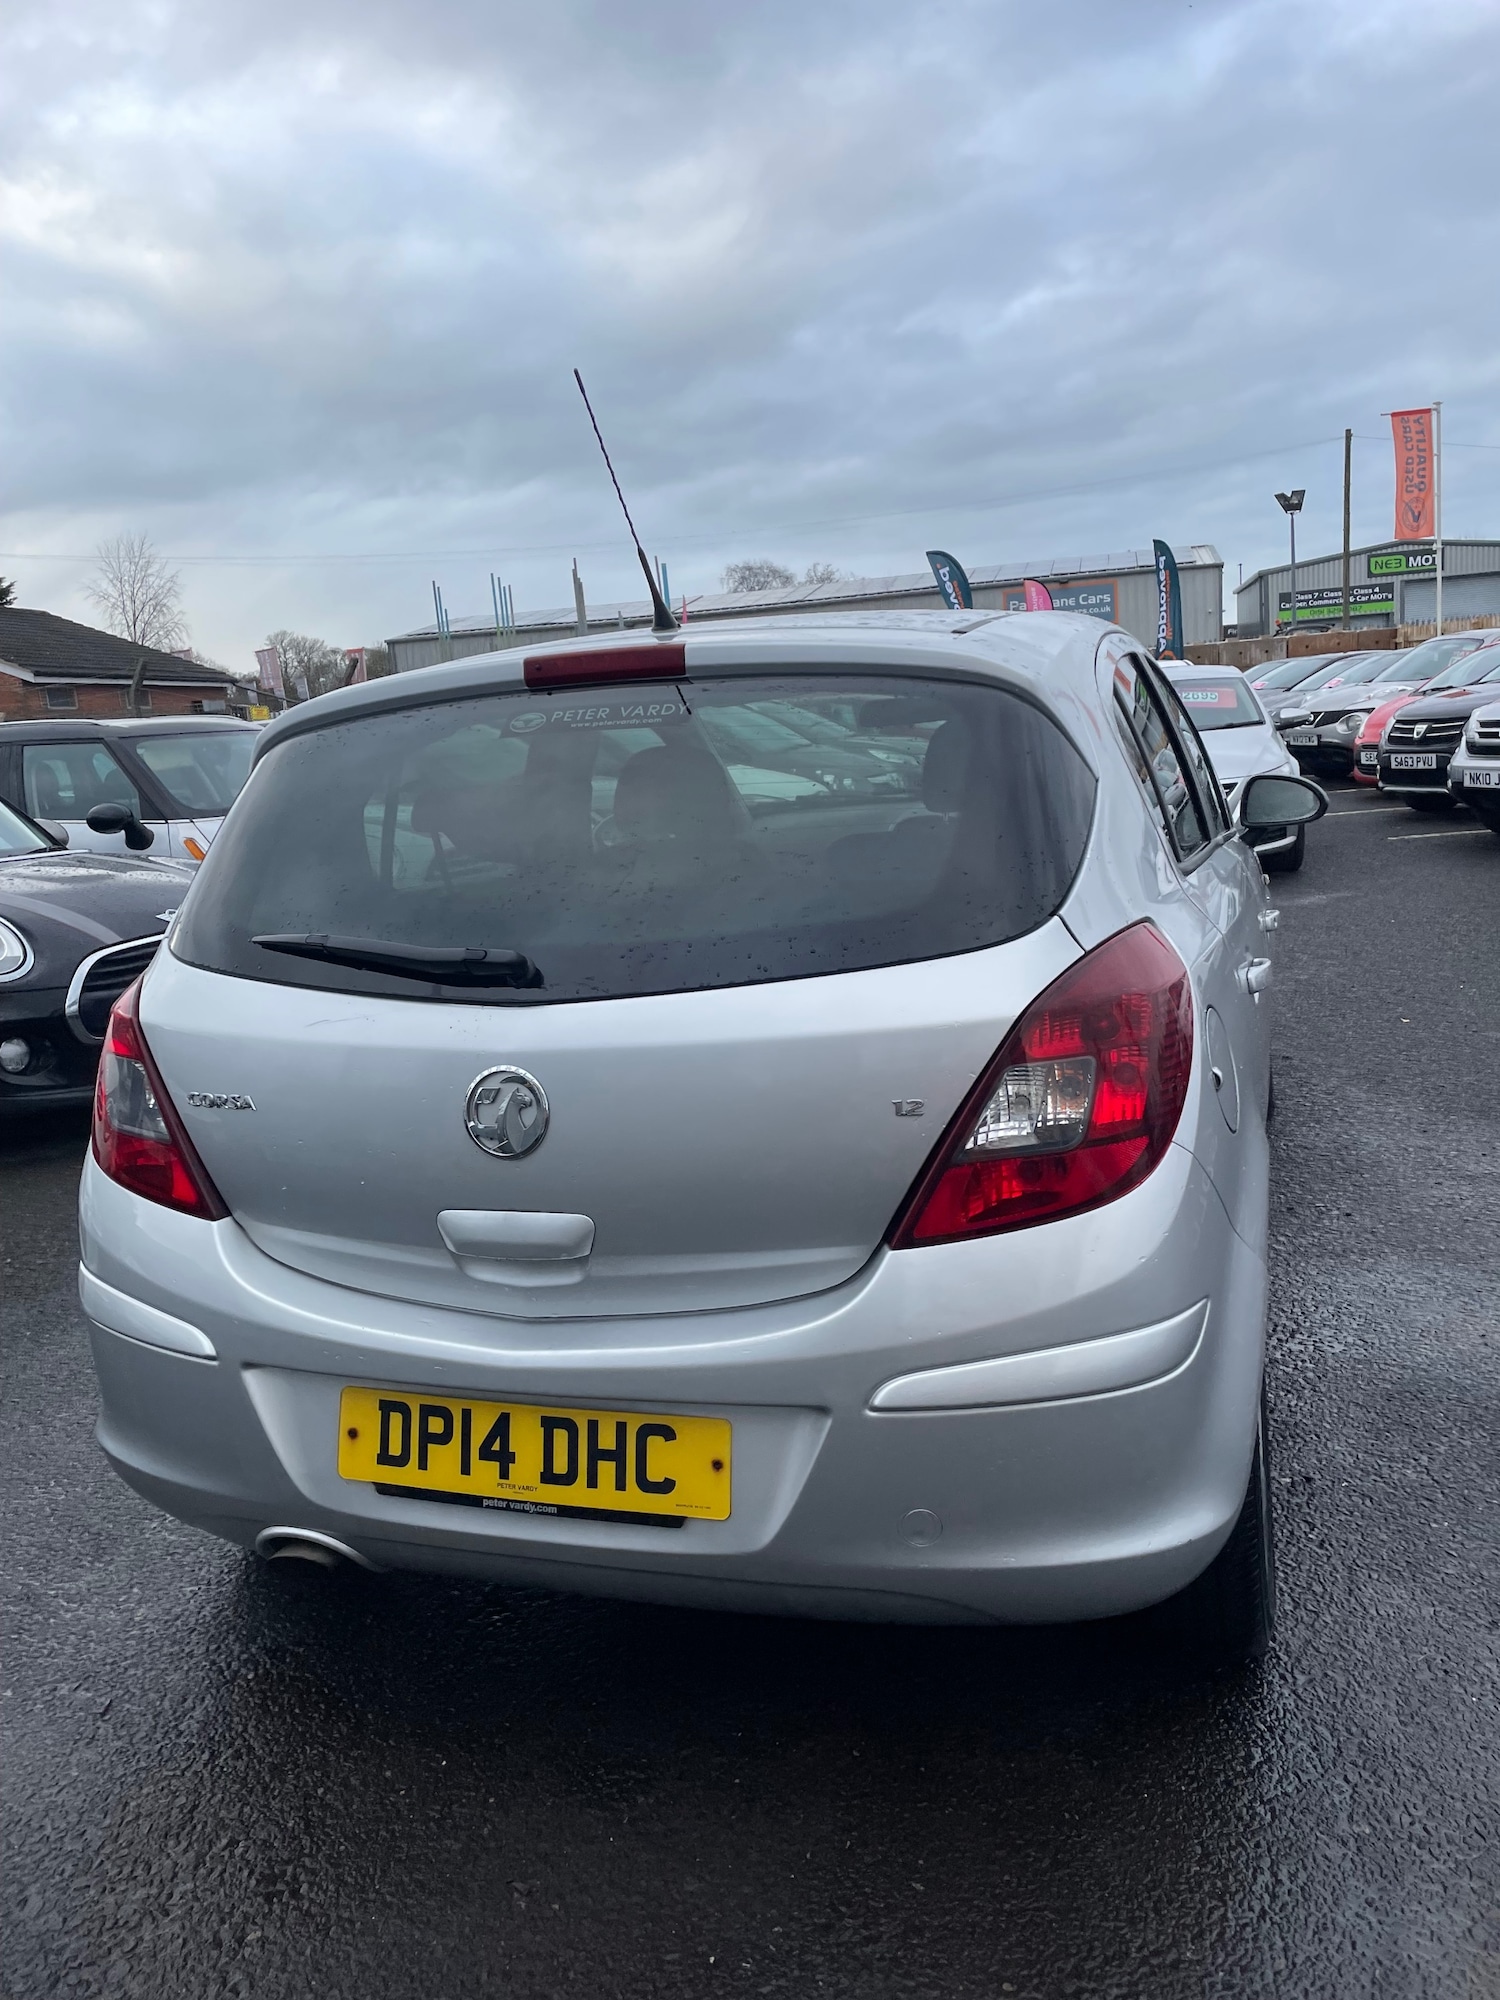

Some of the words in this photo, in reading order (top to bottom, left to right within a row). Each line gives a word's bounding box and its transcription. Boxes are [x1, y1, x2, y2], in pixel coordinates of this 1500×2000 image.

[1079, 594, 1111, 605] Cars
[1356, 594, 1370, 602] Car
[551, 707, 610, 723] PETER
[620, 703, 690, 718] VARDY
[570, 717, 663, 728] www.petervardy.com
[1394, 755, 1415, 768] SA63
[1416, 755, 1433, 768] PVU
[186, 1091, 257, 1112] CORSA
[891, 1098, 925, 1117] 1.2
[376, 1399, 516, 1480] DP14
[540, 1415, 677, 1495] DHC
[496, 1482, 517, 1490] PETER
[482, 1498, 508, 1508] peter
[508, 1501, 558, 1514] vardy.com
